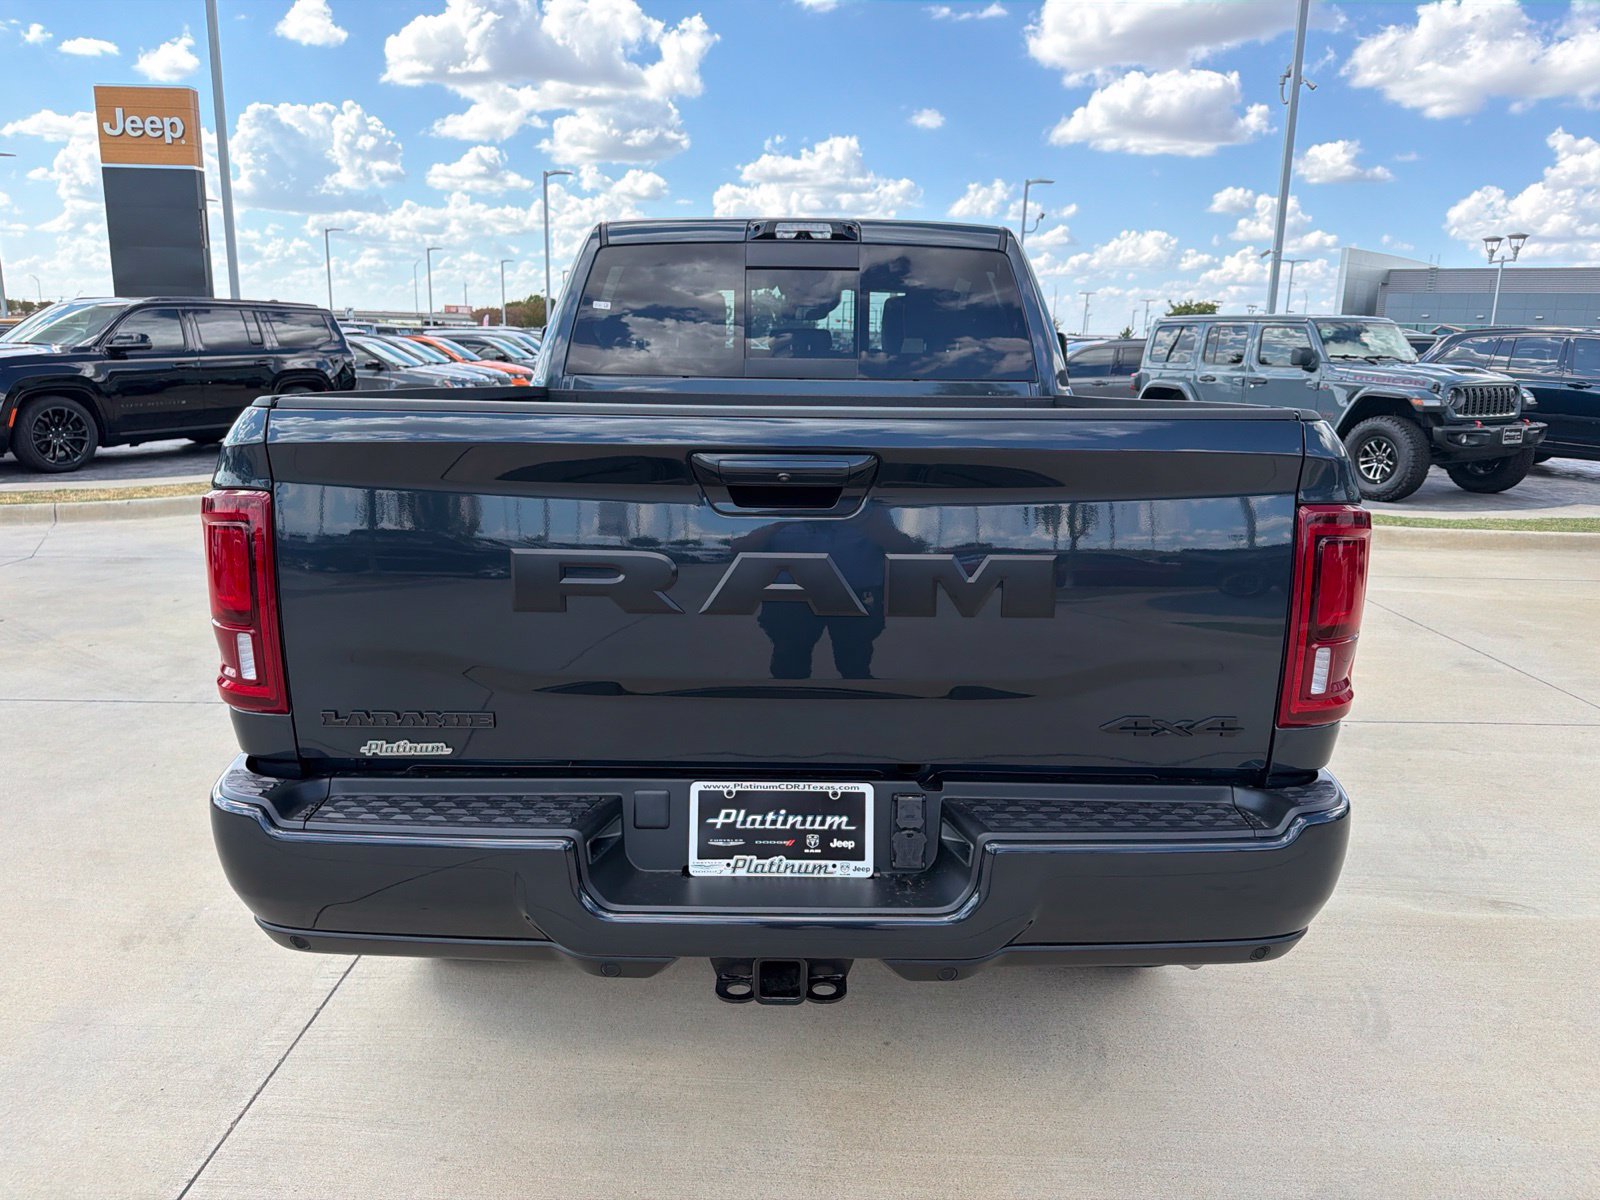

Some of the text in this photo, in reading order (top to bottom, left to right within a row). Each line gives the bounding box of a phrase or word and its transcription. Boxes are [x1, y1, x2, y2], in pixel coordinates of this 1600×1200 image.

[103, 107, 184, 144] Jeep
[1354, 375, 1426, 388] RUBICON
[510, 549, 1057, 618] RAM
[320, 710, 497, 728] LARAMIE
[361, 740, 453, 756] Platinum
[703, 783, 860, 791] www.PlatinumCDRJTexas.com
[706, 809, 857, 830] Platinum
[829, 838, 855, 850] Jeep
[731, 857, 834, 874] Platinum
[852, 865, 871, 873] Jeep
